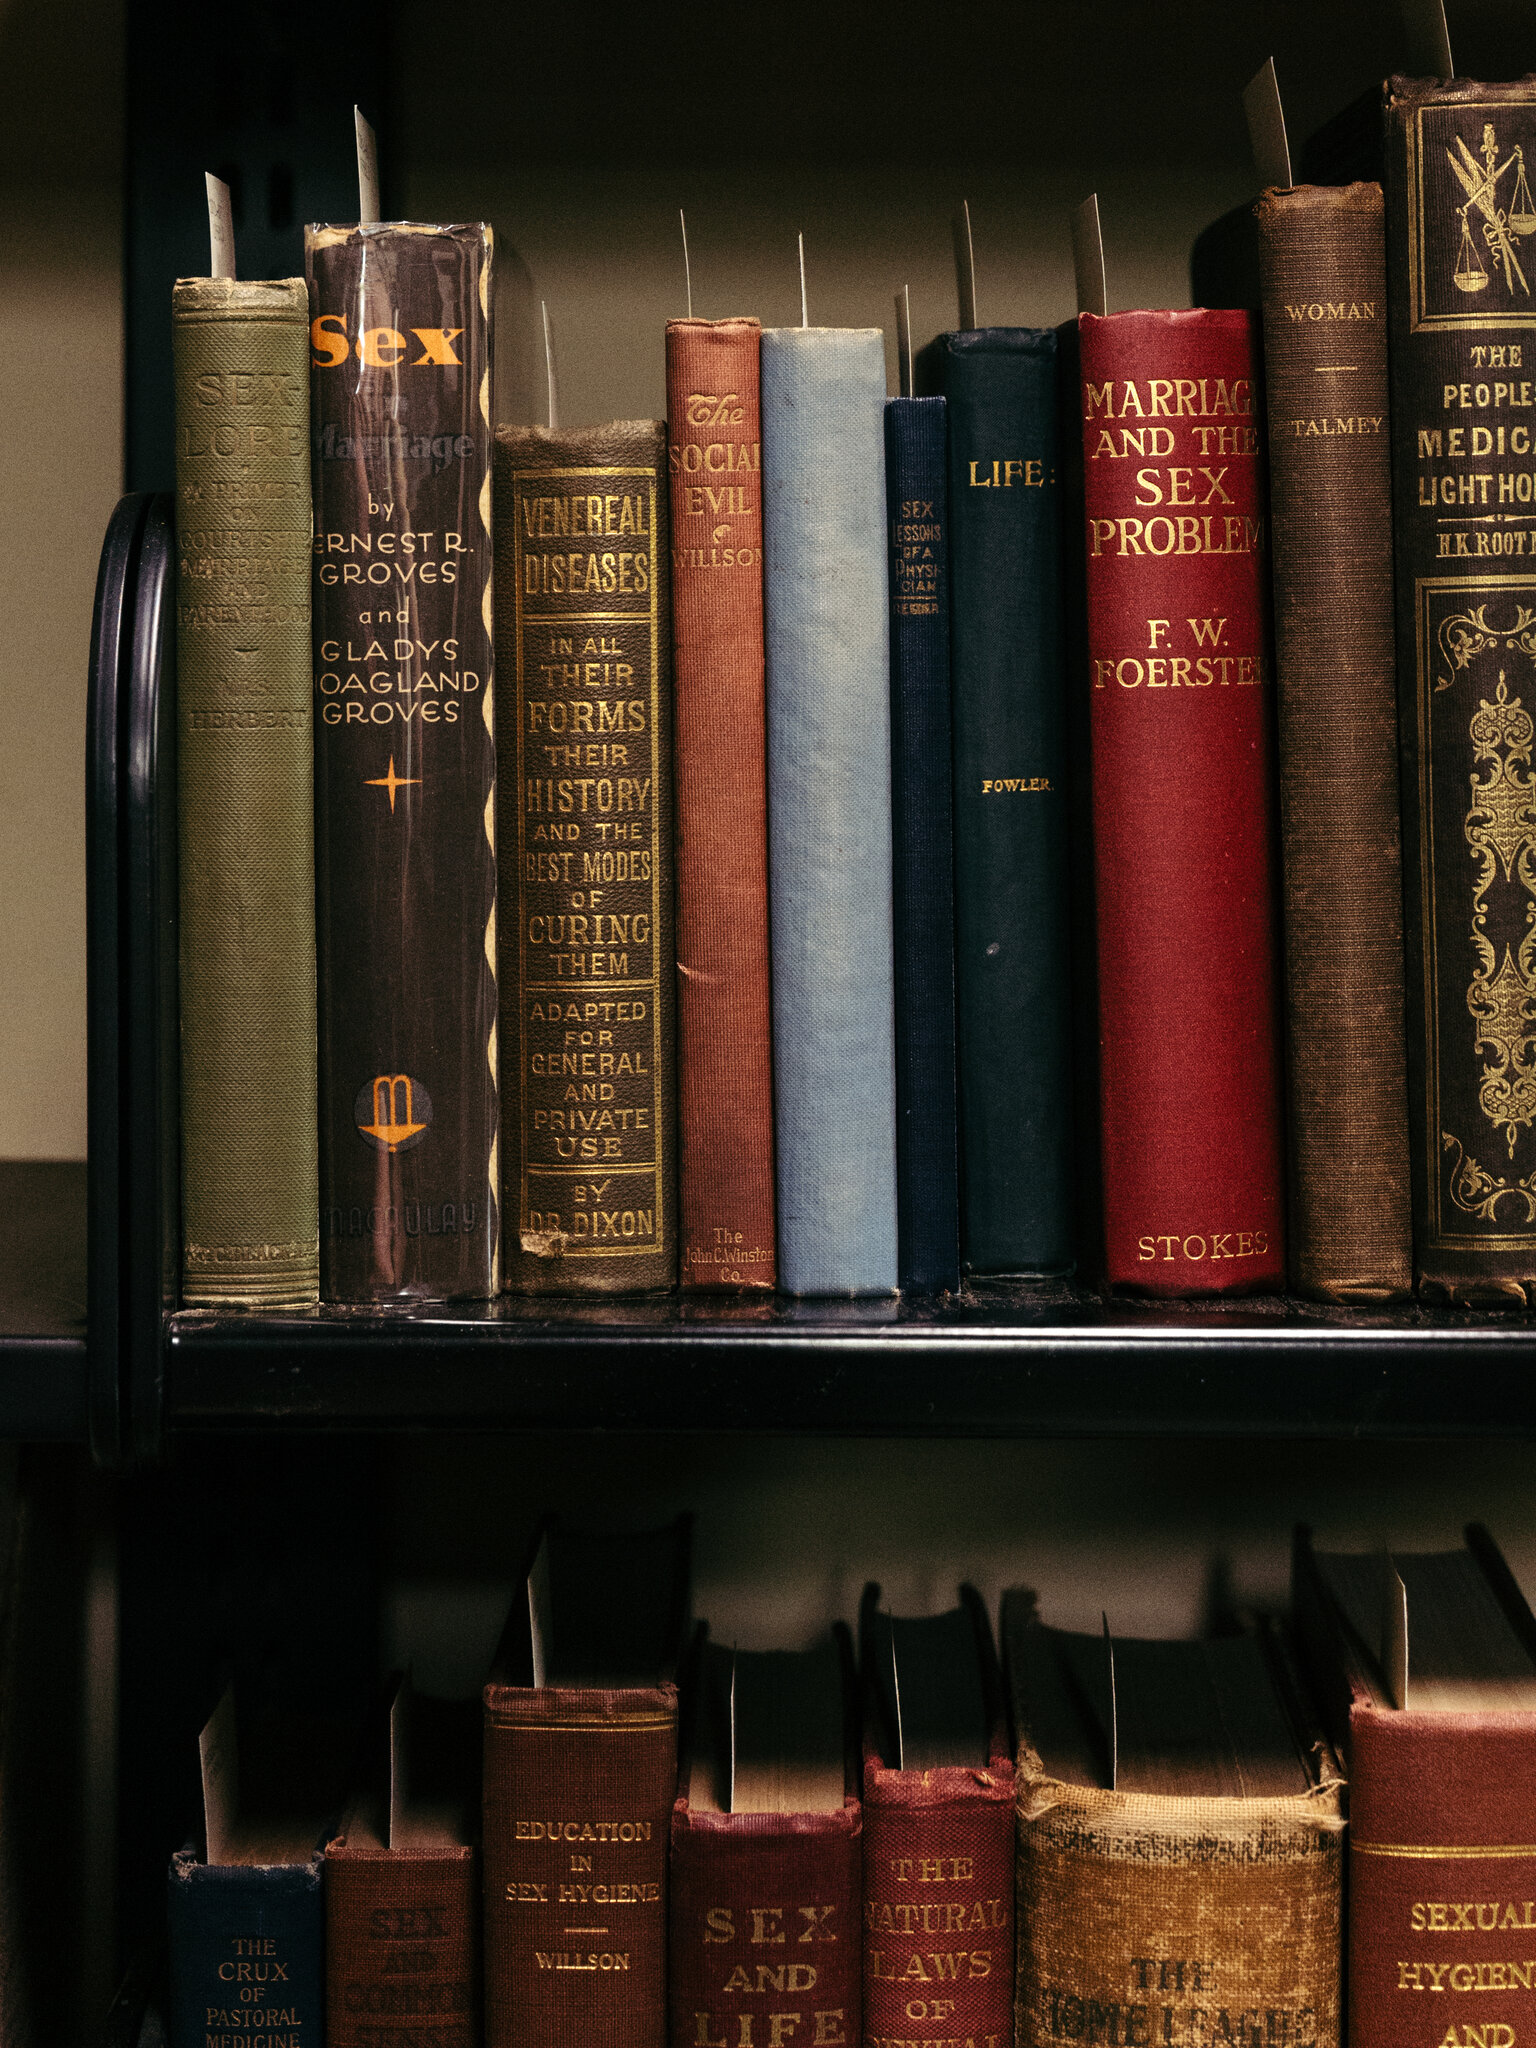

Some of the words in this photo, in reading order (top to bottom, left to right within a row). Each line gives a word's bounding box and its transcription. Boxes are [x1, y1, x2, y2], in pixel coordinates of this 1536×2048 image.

[1284, 302, 1376, 321] WOMAN
[311, 312, 466, 369] Sex
[1470, 344, 1523, 369] THE
[1443, 381, 1536, 409] PEOPLE
[686, 392, 746, 427] The
[1291, 416, 1384, 437] TALMEY
[1091, 426, 1176, 459] AND
[1191, 426, 1260, 456] THE
[1417, 426, 1536, 459] MEDIC
[1134, 466, 1236, 507] SEX
[368, 492, 395, 522] by
[684, 486, 753, 515] EVIL
[901, 500, 935, 519] SEX
[522, 495, 649, 538] VENEREAL
[445, 532, 475, 553] R.
[1474, 531, 1527, 557] ROOT
[319, 560, 457, 585] GROVES
[525, 552, 649, 594] DISEASES
[358, 594, 411, 624] and
[550, 637, 574, 654] IN
[582, 637, 623, 653] ALL
[1146, 618, 1173, 649] F.
[1186, 617, 1229, 648] W.
[320, 638, 459, 662] GLADYS
[315, 671, 480, 695] OAGLAND
[540, 662, 634, 686] THEIR
[322, 700, 460, 725] GROVES
[528, 700, 647, 733] FORMS
[544, 744, 629, 767] THEIR
[526, 778, 651, 813] HISTORY
[533, 823, 580, 841] AND
[595, 823, 643, 840] THE
[525, 852, 574, 882] BEST
[583, 851, 651, 882] MODES
[571, 890, 604, 909] OF
[528, 913, 651, 945] CURING
[549, 952, 629, 976] THEM
[529, 1001, 647, 1022] ADAPTED
[564, 1030, 614, 1046] FOR
[531, 1052, 649, 1076] GENERAL
[563, 1083, 615, 1101] AND
[533, 1107, 650, 1131] PRIVATE
[554, 1136, 623, 1158] USE
[574, 1178, 612, 1203] BY
[573, 1209, 654, 1238] DIXON
[713, 1227, 744, 1244] The
[1137, 1230, 1270, 1261] STOKES
[515, 1820, 652, 1842] EDUCATION
[569, 1854, 592, 1872] IN
[890, 1856, 974, 1882] THE
[505, 1883, 548, 1903] SEX
[558, 1883, 660, 1904] HYGIENE
[704, 1905, 838, 1944] SEX
[231, 1938, 277, 1956] THE
[217, 1961, 290, 1982] CRUX
[535, 1951, 631, 1971] WILLSON
[869, 1949, 994, 1982] LAWS
[722, 1963, 818, 1993] AND
[1130, 1957, 1218, 1992] THE
[1397, 1960, 1536, 1992] HYGIEN
[239, 1987, 266, 2003] OF
[205, 2007, 302, 2028] PASTORAL
[905, 1999, 956, 2020] OF
[693, 2008, 847, 2048] LIFE
[1437, 2022, 1517, 2048] AND
